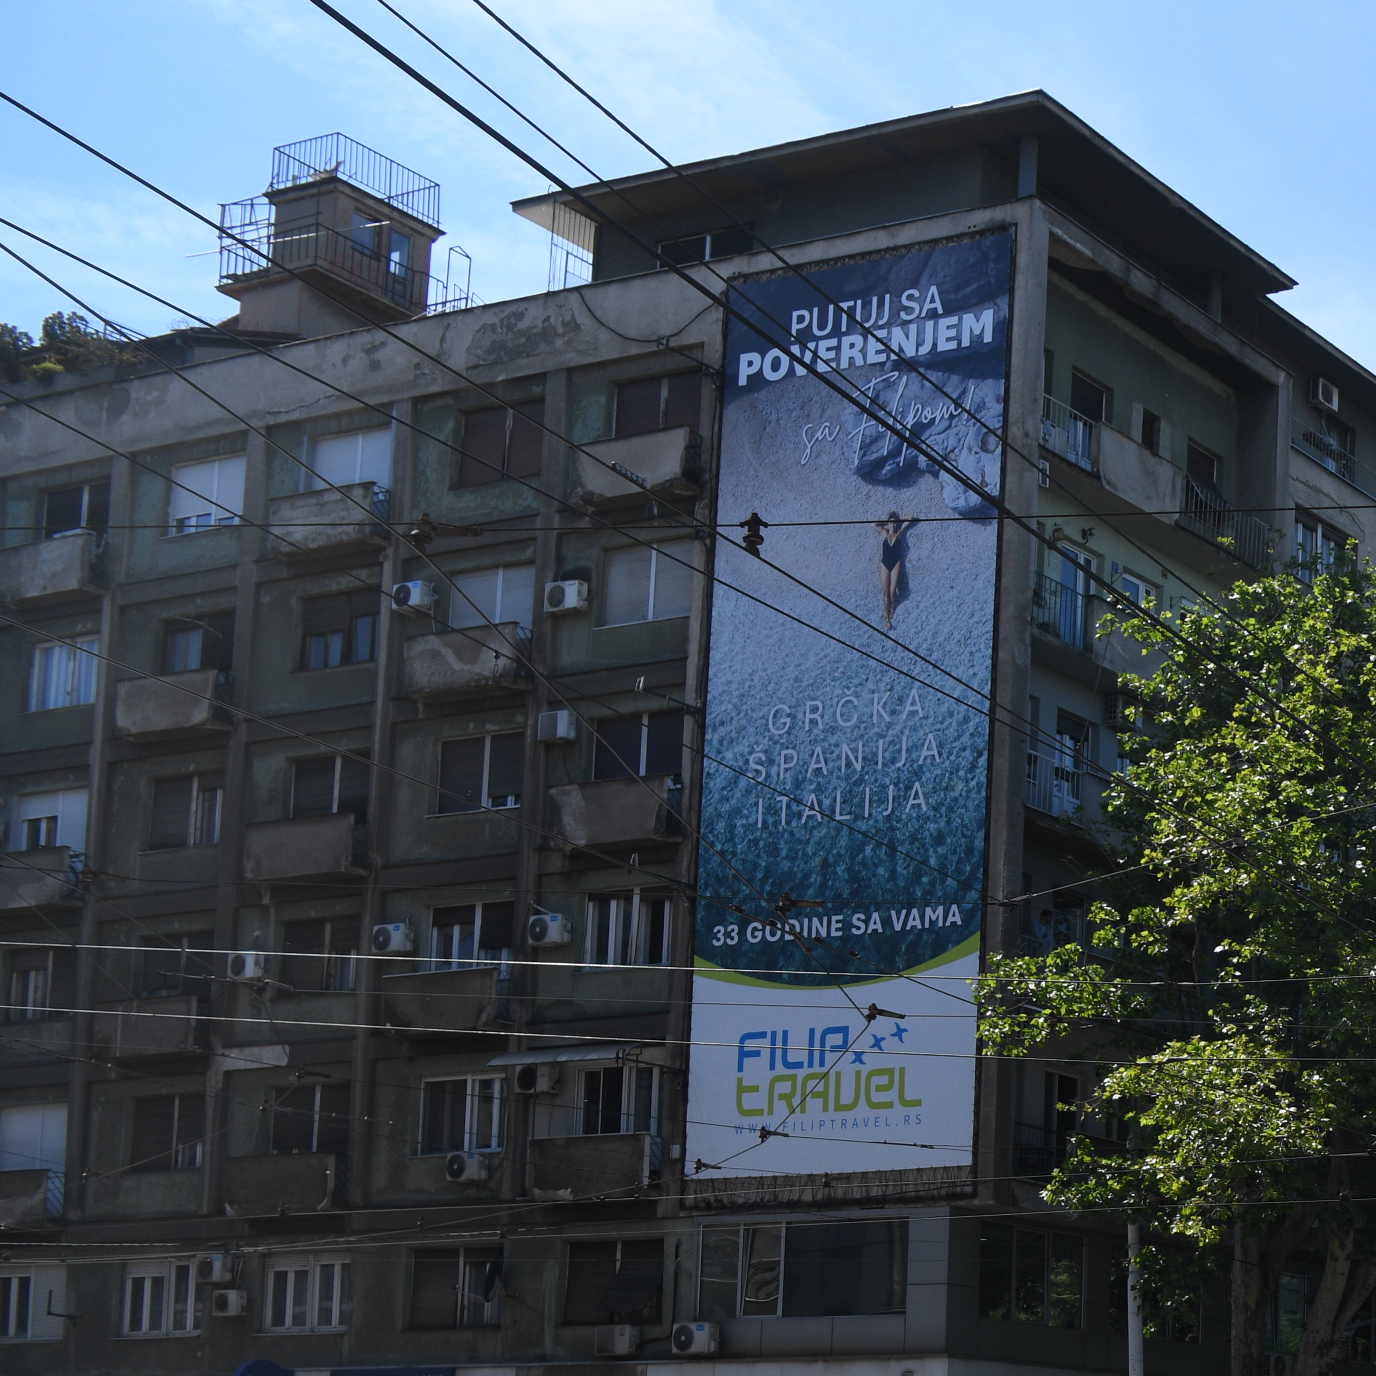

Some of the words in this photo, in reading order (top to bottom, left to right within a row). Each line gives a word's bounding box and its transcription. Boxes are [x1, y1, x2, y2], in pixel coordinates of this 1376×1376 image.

[790, 295, 890, 341] PUTUJ
[900, 285, 943, 321] SA
[738, 308, 994, 386] POVERENJEM
[800, 422, 841, 465] sa
[768, 687, 924, 735] GRČKA
[748, 732, 942, 784] ŠPANIJA
[757, 781, 927, 828] ITALIJA
[712, 924, 739, 947] 33
[746, 914, 843, 944] GODINE
[851, 912, 883, 935] SA
[891, 904, 963, 930] VAMA
[737, 1025, 850, 1073] FILIP
[735, 1113, 922, 1136] WWWFILIPTRAVEL.RS
